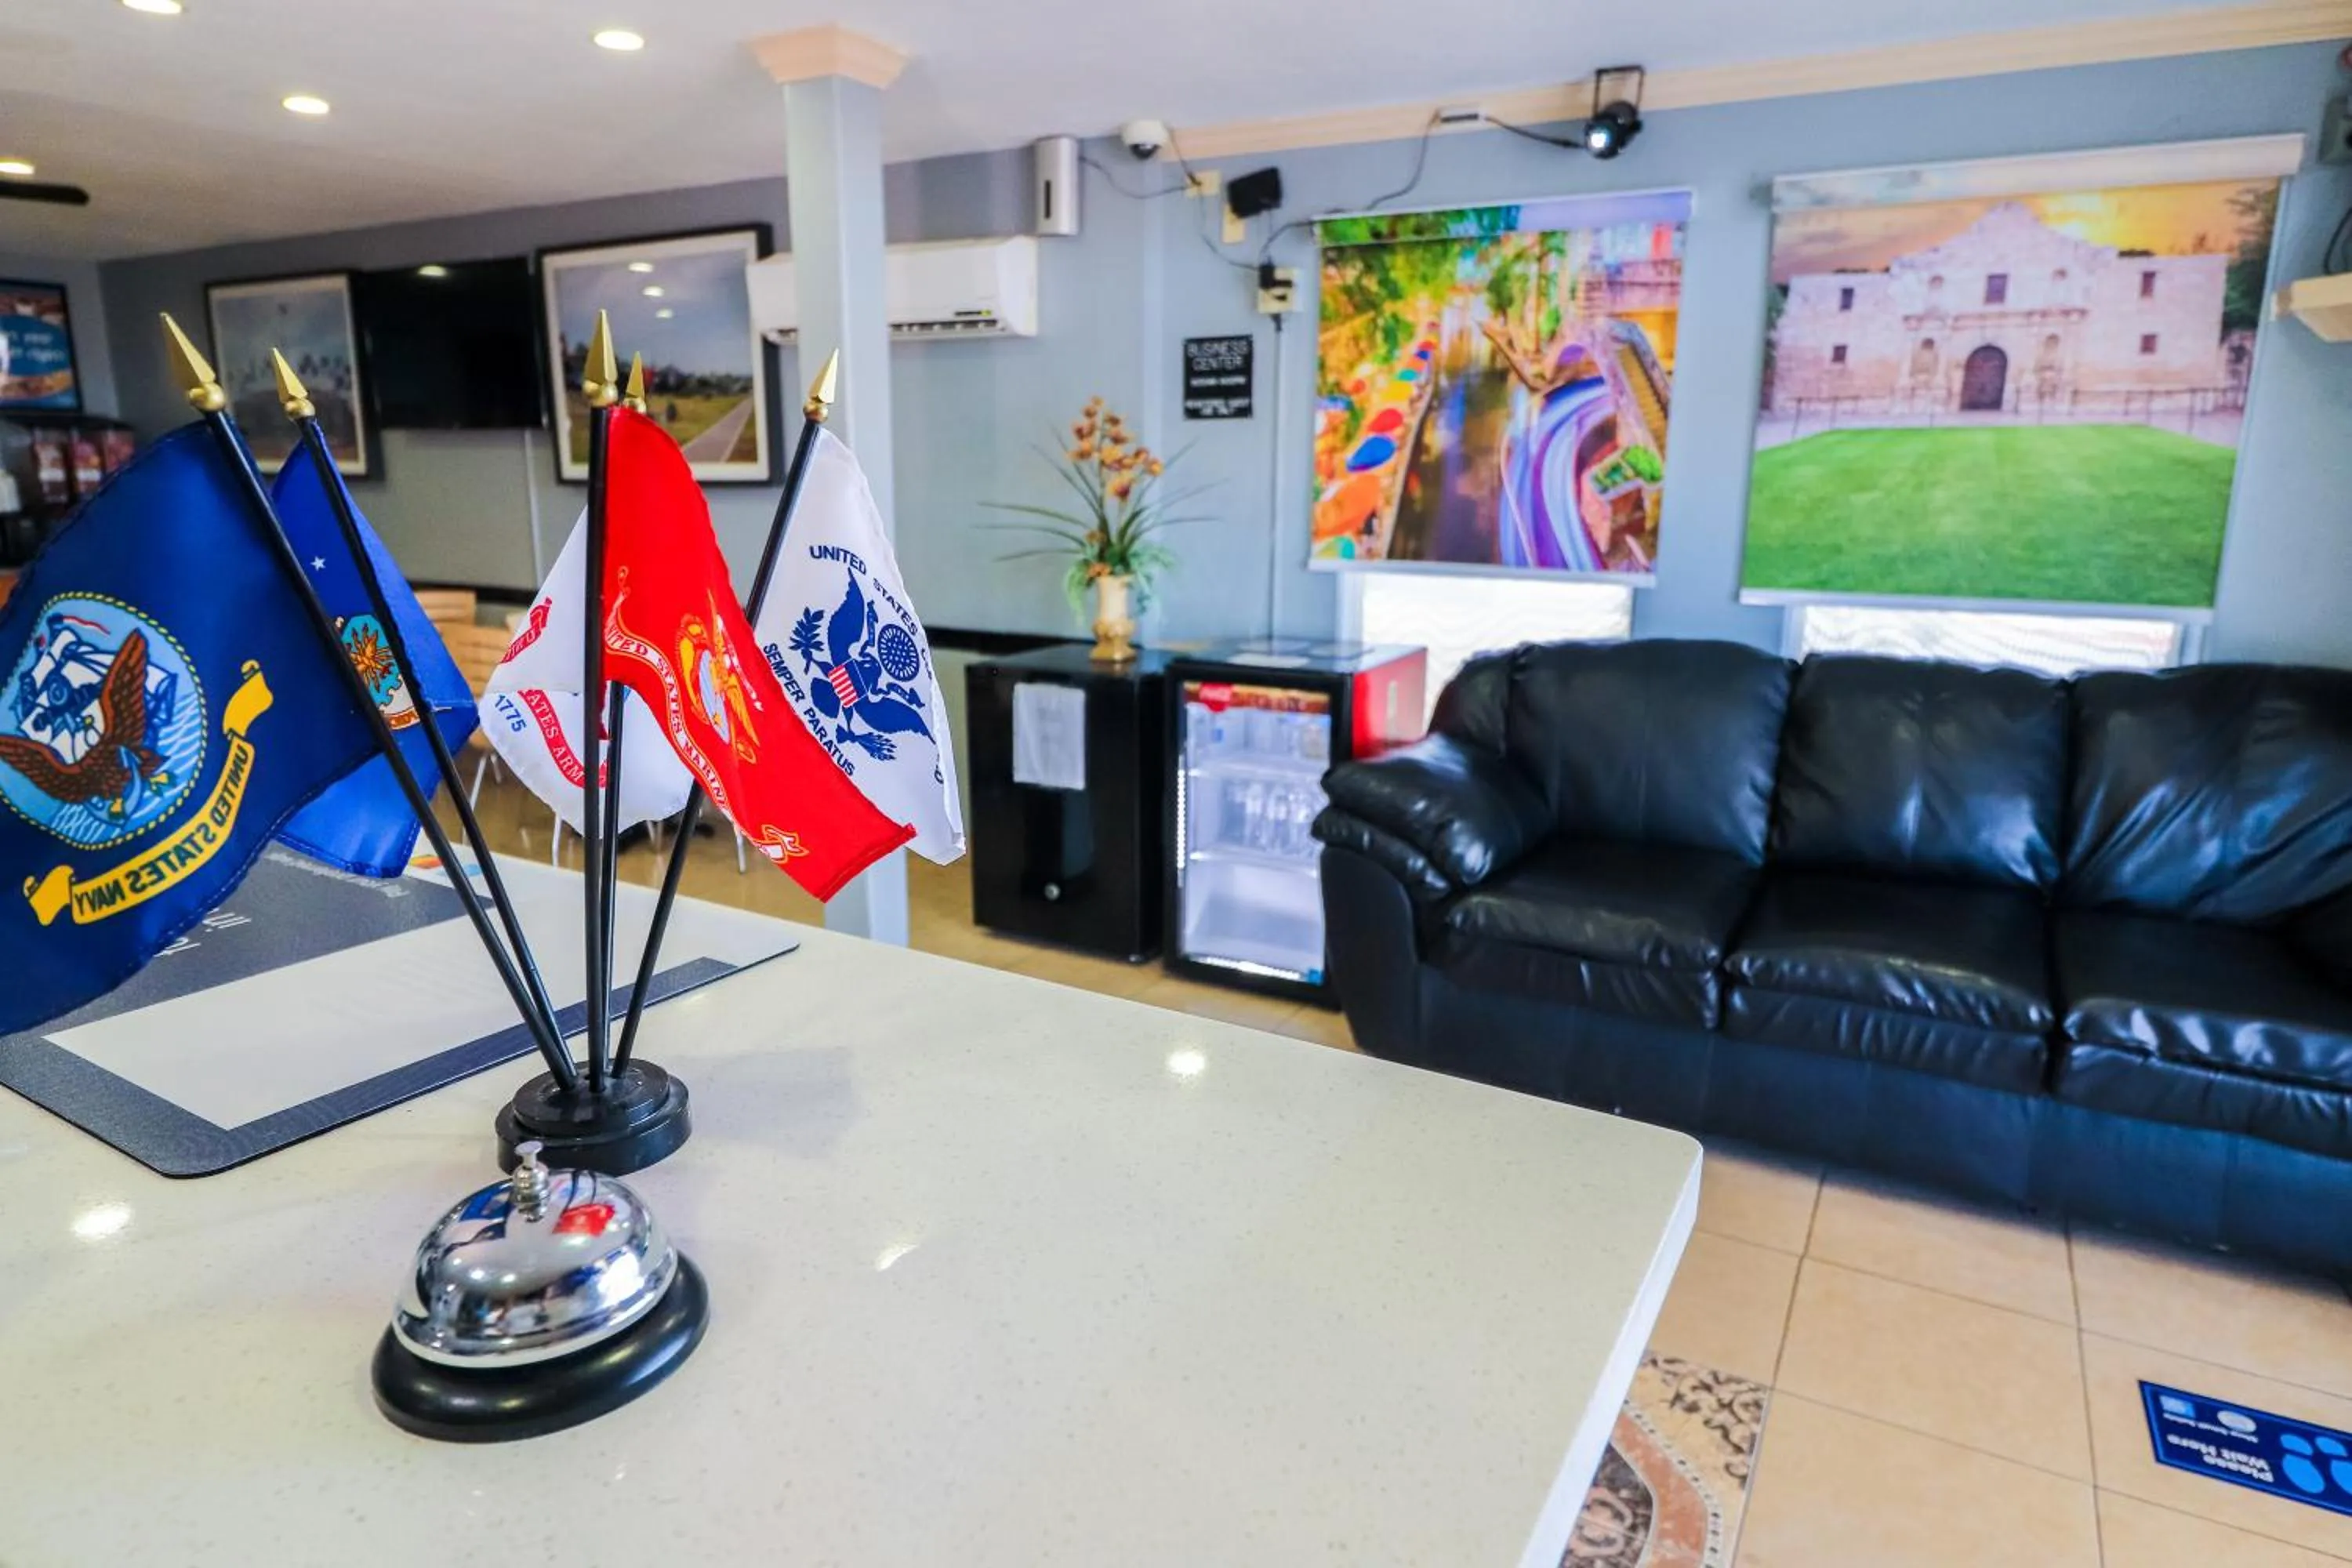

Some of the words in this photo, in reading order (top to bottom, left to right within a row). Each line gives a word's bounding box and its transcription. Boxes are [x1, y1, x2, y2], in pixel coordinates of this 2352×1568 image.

[1187, 340, 1249, 358] BUSINESS
[1192, 356, 1243, 371] CENTER
[808, 544, 867, 575] UNITED
[873, 577, 919, 637] STATES
[607, 625, 648, 656] ITED
[494, 694, 527, 733] 1775
[763, 643, 805, 703] SEMPER
[804, 707, 855, 776] PARATUS
[518, 689, 559, 739] ATES
[553, 746, 586, 782] ARM
